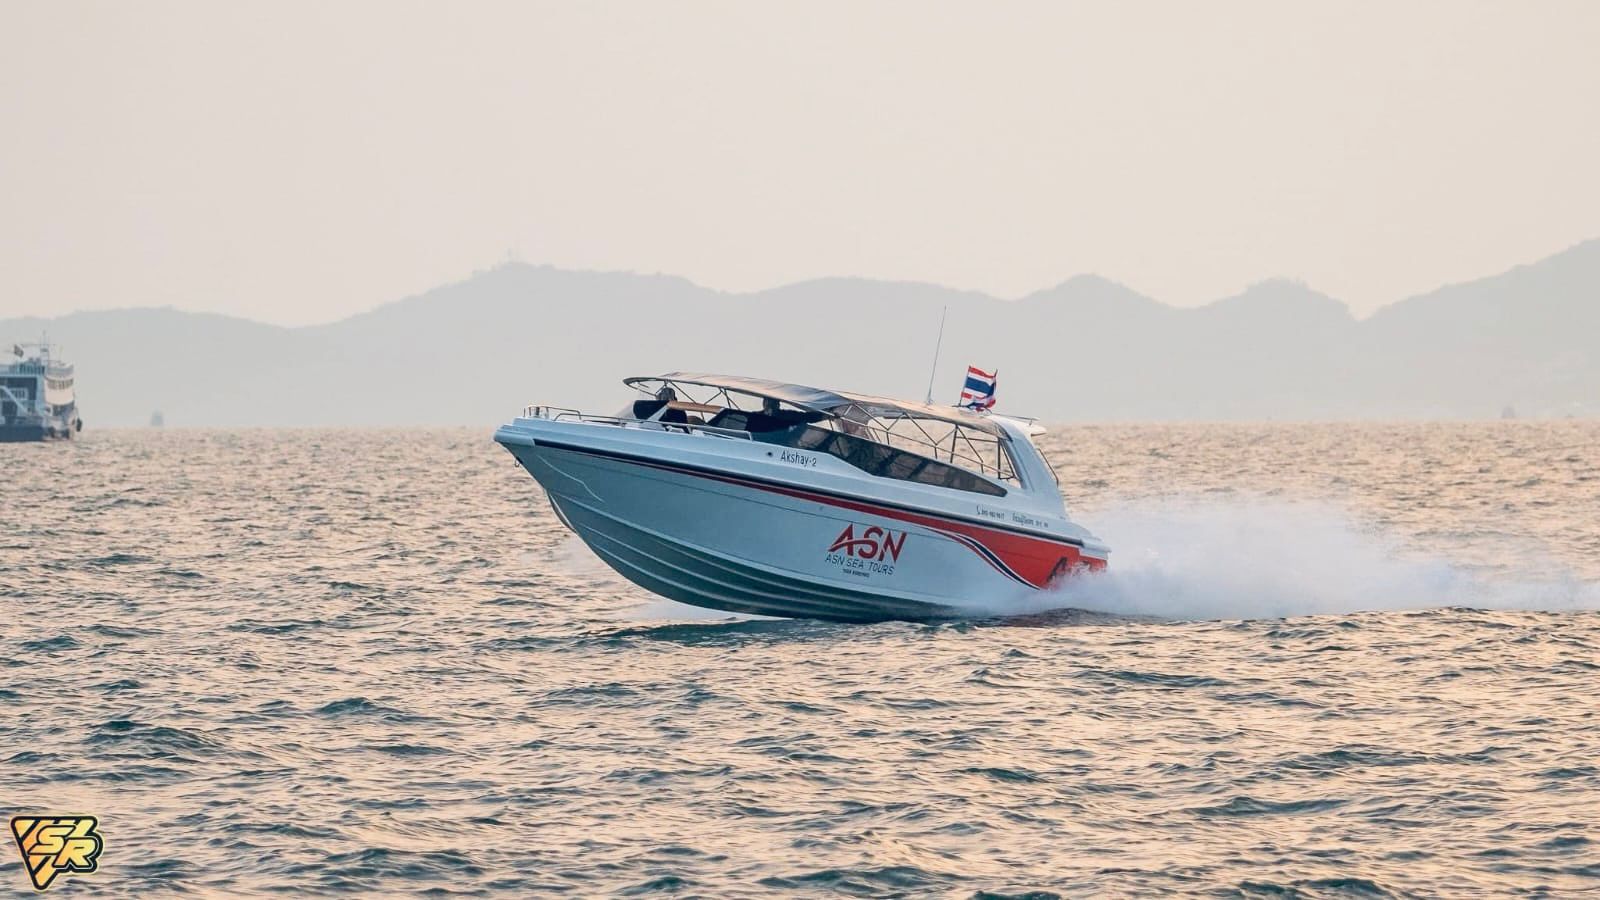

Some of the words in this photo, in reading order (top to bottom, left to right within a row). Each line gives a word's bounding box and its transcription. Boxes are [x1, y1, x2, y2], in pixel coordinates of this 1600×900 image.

[780, 450, 817, 468] Akshay-2
[827, 523, 907, 563] ASN
[825, 554, 845, 566] ASN
[846, 558, 864, 569] SEA
[869, 561, 895, 575] TOURS
